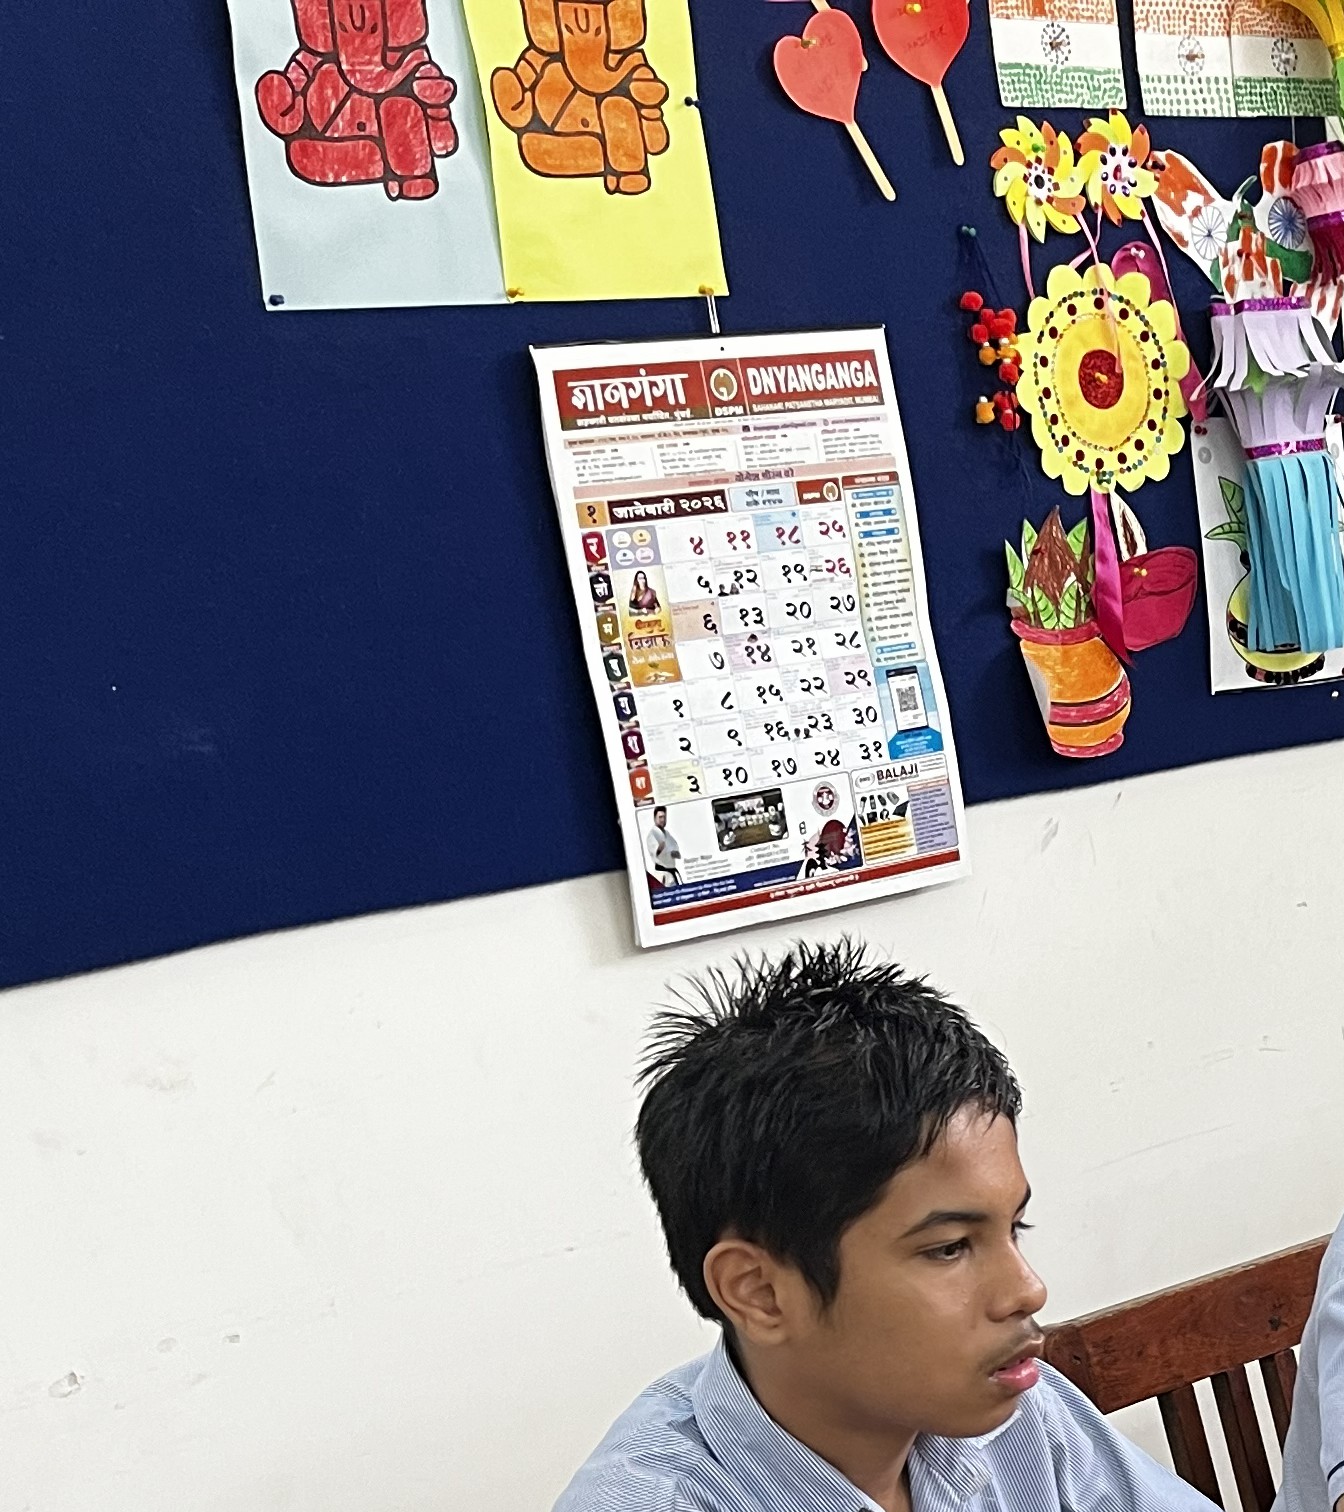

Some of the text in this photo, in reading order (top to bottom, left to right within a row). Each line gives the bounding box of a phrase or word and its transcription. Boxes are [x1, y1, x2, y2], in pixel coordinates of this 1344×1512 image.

[747, 359, 877, 396] DNYANGANGA
[715, 405, 744, 417] DSPM
[587, 505, 597, 523] १
[612, 495, 726, 520] जानेवारी २०२६
[775, 525, 801, 546] १८
[818, 519, 847, 540] २५
[689, 536, 704, 556] ४
[726, 530, 751, 551] ११
[781, 563, 808, 584] १९
[824, 557, 852, 578] २६
[697, 575, 713, 594] ५
[733, 569, 761, 590] १२
[785, 601, 812, 621] २०
[829, 594, 857, 614] २७
[703, 613, 718, 634] ६
[739, 606, 766, 628] १३
[790, 637, 818, 657] २१
[834, 630, 862, 650] २८
[708, 651, 725, 670] ७
[744, 643, 772, 665] १४
[799, 676, 828, 697] २२
[844, 669, 872, 690] २९
[720, 691, 735, 710] ८
[756, 684, 784, 704] १५
[672, 699, 684, 718] १
[852, 705, 878, 728] ३०
[763, 720, 792, 741] १६
[807, 713, 835, 733] २३
[678, 737, 695, 756] २
[727, 728, 743, 747] ९
[814, 748, 841, 768] २४
[859, 740, 883, 762] ३१
[722, 766, 748, 787] १०
[771, 757, 798, 778] १७
[876, 762, 919, 781] BALAJI
[687, 775, 703, 795] ३
